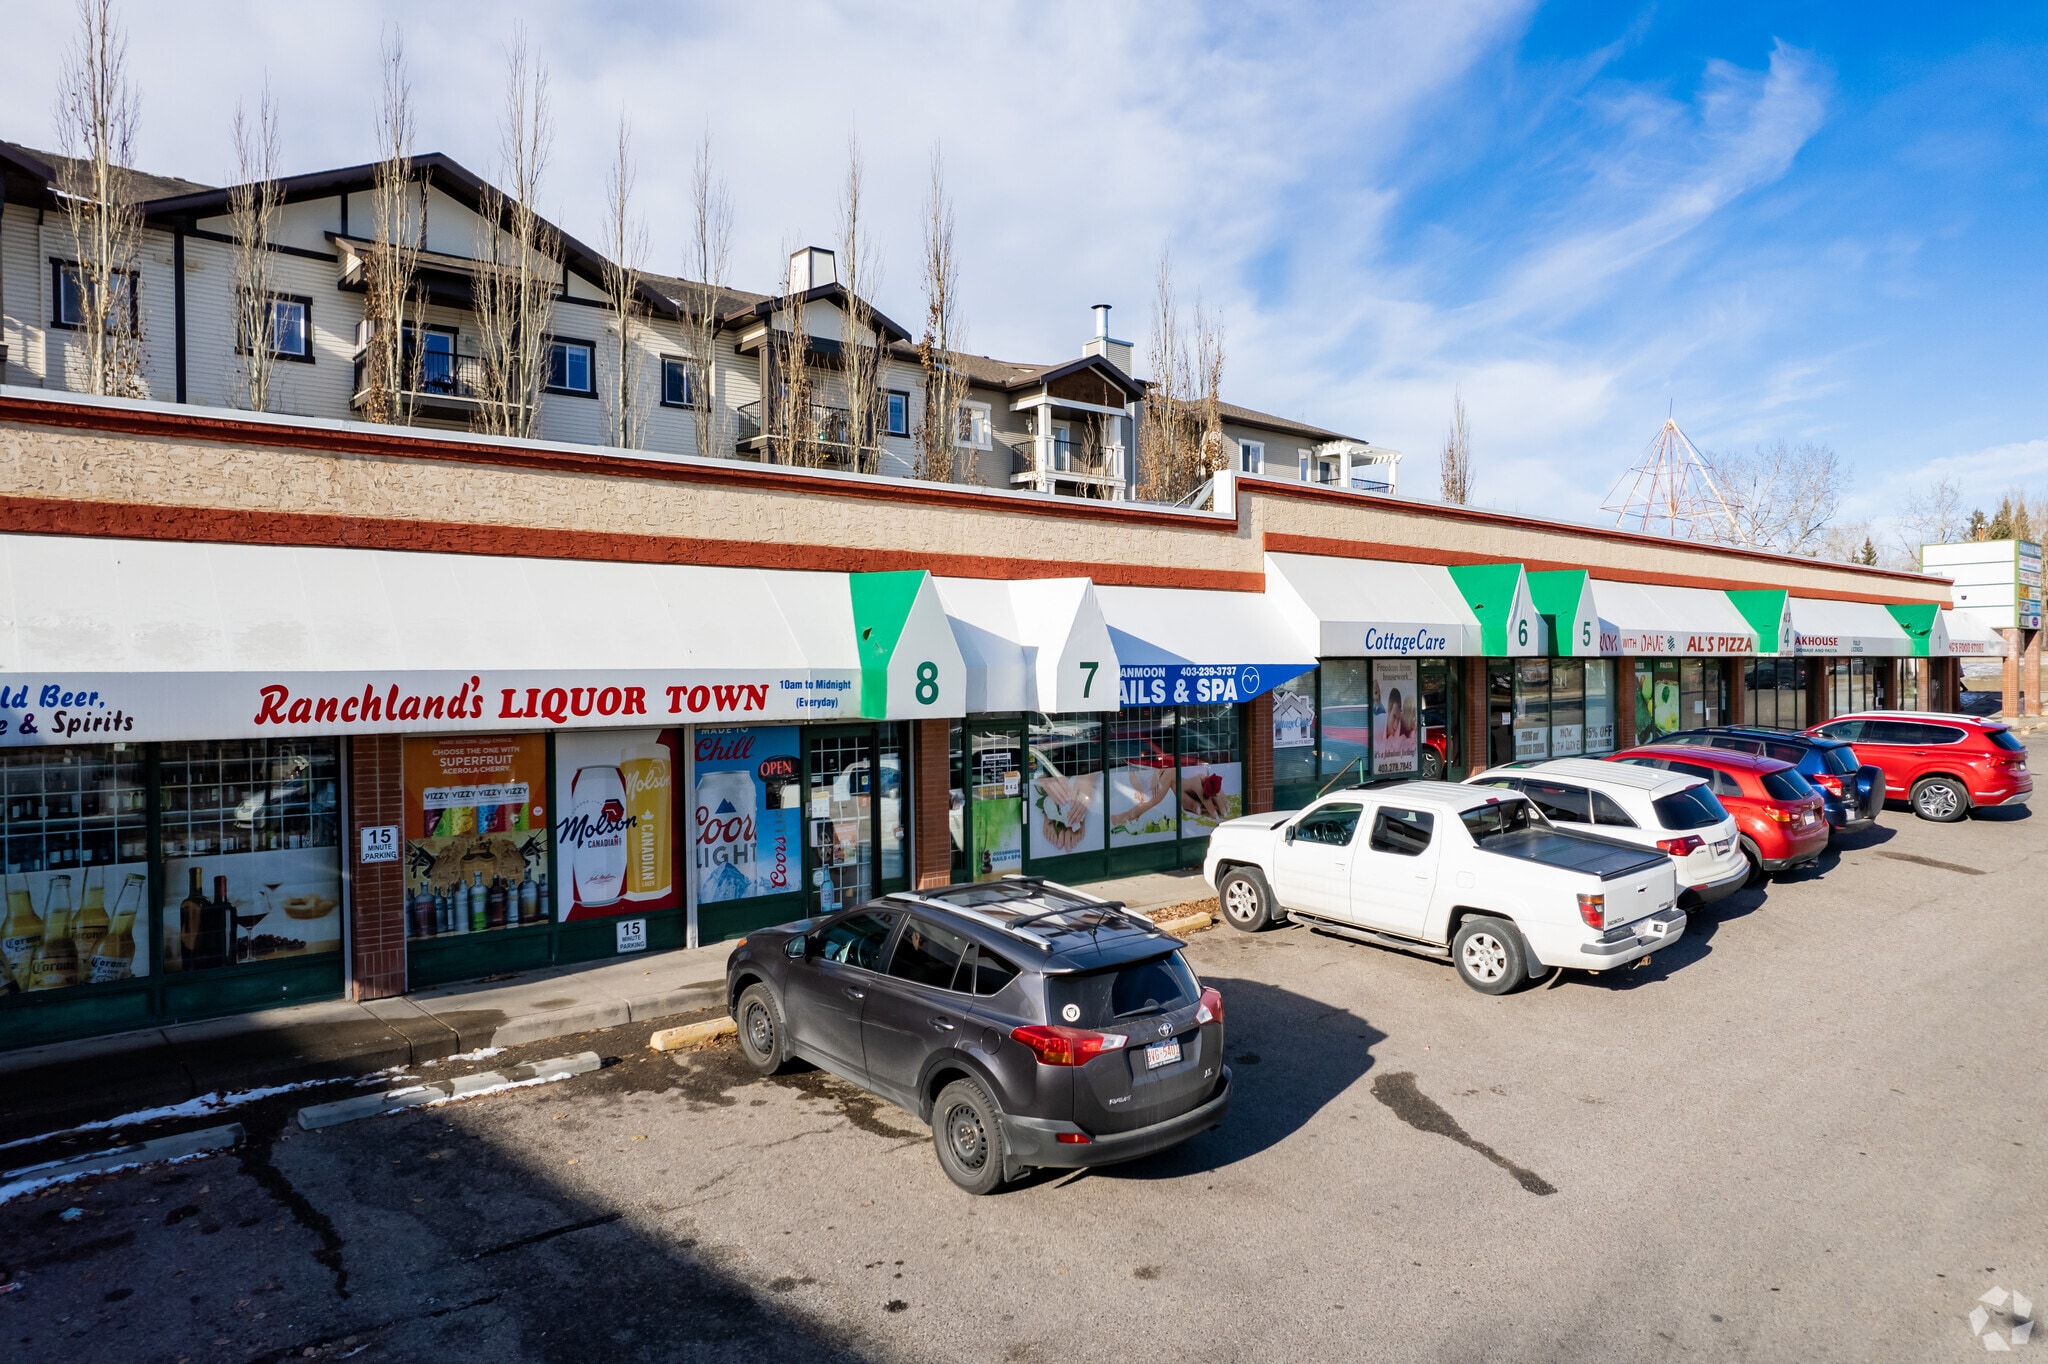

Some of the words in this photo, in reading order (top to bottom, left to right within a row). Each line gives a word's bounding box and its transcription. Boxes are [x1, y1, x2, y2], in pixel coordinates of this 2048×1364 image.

[1366, 627, 1445, 655] CottageCare
[1518, 619, 1528, 646] 6
[1582, 622, 1591, 647] 5
[1784, 628, 1790, 647] 4
[1622, 638, 1637, 648] WITH
[1641, 634, 1664, 652] DAVE
[1686, 636, 1714, 652] AL'S
[1718, 637, 1753, 652] PIZZA
[1079, 662, 1099, 698] 7
[1120, 667, 1166, 678] ANMOON
[1180, 666, 1237, 676] 403-239-3737
[779, 680, 802, 689] 10am
[805, 680, 813, 689] to
[816, 680, 851, 691] Midnight
[915, 661, 939, 705] 8
[1120, 679, 1166, 704] AILS
[1173, 678, 1190, 703] &
[1196, 678, 1238, 702] SPA
[39, 684, 105, 708] Beer,
[254, 675, 484, 725] Ranchland's
[498, 686, 647, 723] LIQUOR
[666, 684, 769, 713] TOWN
[796, 697, 838, 709] (Everyday)
[19, 713, 38, 734] &
[52, 710, 133, 738] Spirits
[1586, 727, 1598, 739] 15%
[1600, 725, 1612, 737] OFF
[695, 736, 756, 762] Chill
[439, 754, 513, 768] SUPERFRUIT
[760, 761, 792, 776] OPEN
[451, 790, 476, 798] VIZZY
[504, 787, 527, 795] VIZZY
[625, 770, 671, 801] Molson
[425, 792, 449, 800] VIZZY
[369, 829, 391, 844] 15
[555, 814, 637, 849] Molson
[367, 843, 392, 851] MINUTE
[588, 836, 618, 848] CANADIAN
[365, 851, 396, 860] PARKING
[641, 824, 655, 880] CANADIAN
[770, 835, 787, 889] Coors
[623, 922, 640, 936] 15
[620, 941, 645, 949] PARKING
